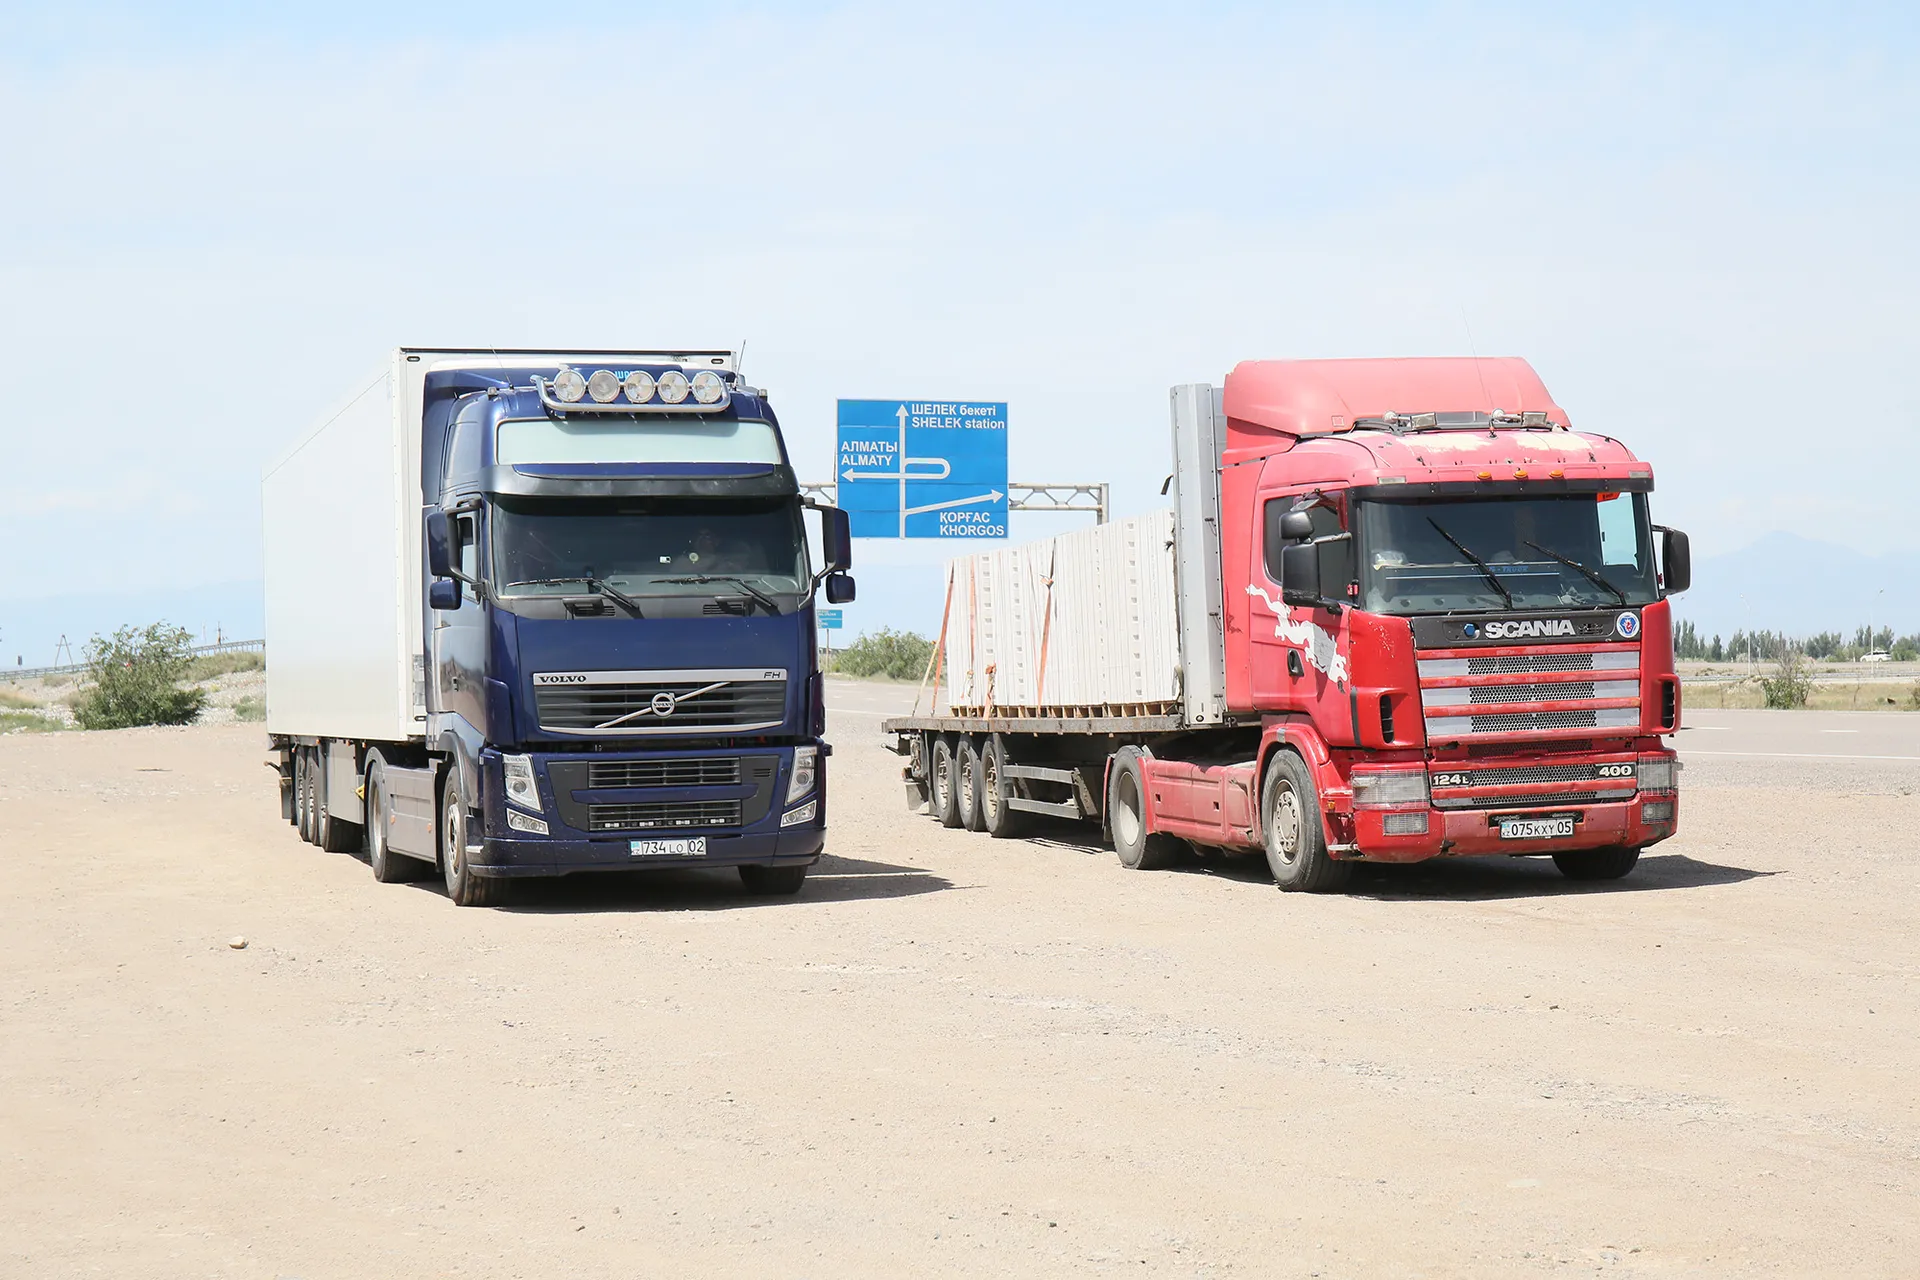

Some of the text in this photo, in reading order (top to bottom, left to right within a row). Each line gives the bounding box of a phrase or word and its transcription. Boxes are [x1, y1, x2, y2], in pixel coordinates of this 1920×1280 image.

[911, 403, 996, 416] ШЕЛЕК бекеті
[911, 417, 1005, 430] SHELEK station
[841, 441, 898, 453] АЛМАТЫ
[841, 454, 893, 466] ALMATY
[939, 524, 1005, 536] KHORGOS
[1484, 619, 1577, 639] SCANIA
[538, 675, 587, 683] VOLVO
[763, 671, 781, 679] FH
[1598, 765, 1632, 777] 400
